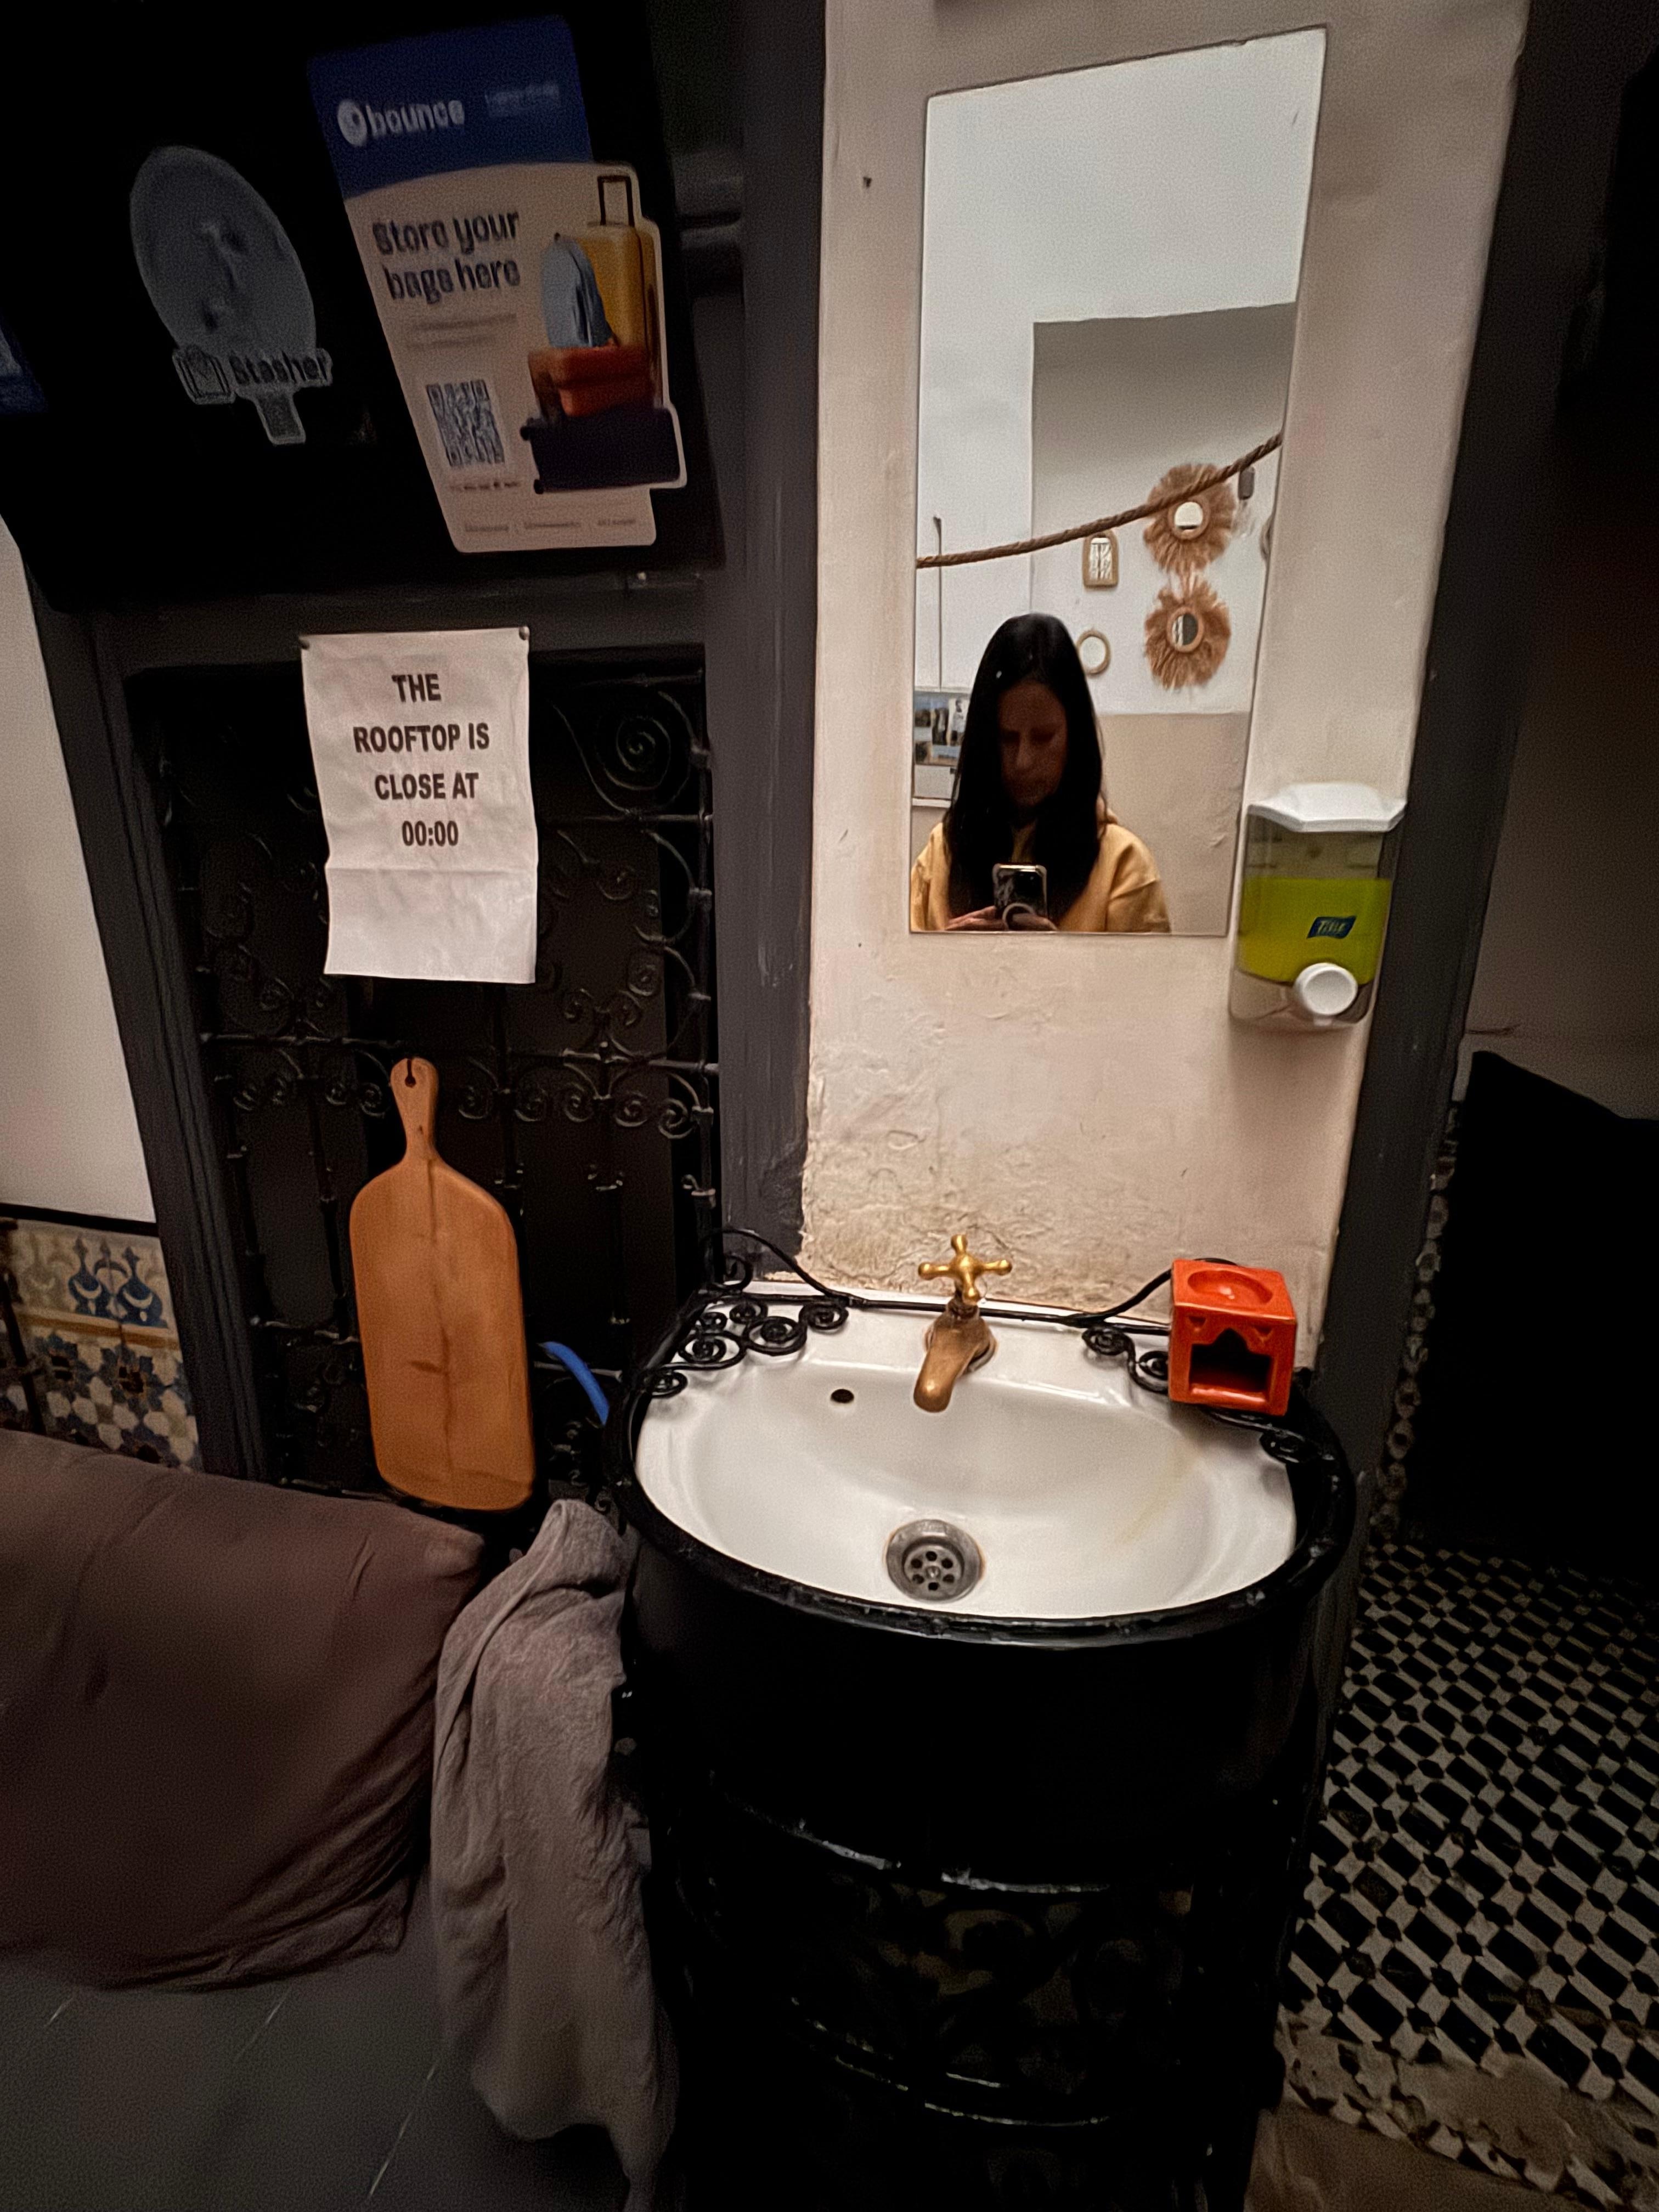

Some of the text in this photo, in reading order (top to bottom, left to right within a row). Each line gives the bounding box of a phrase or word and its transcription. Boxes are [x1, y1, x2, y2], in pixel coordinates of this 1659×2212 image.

[365, 99, 466, 138] bounce
[373, 211, 520, 256] Store your
[383, 258, 521, 304] bags here
[227, 349, 329, 385] Stasher
[391, 673, 442, 703] THE
[353, 722, 490, 753] ROOFTOP IS
[374, 772, 479, 800] CLOSE AT
[401, 820, 459, 847] 00:00
